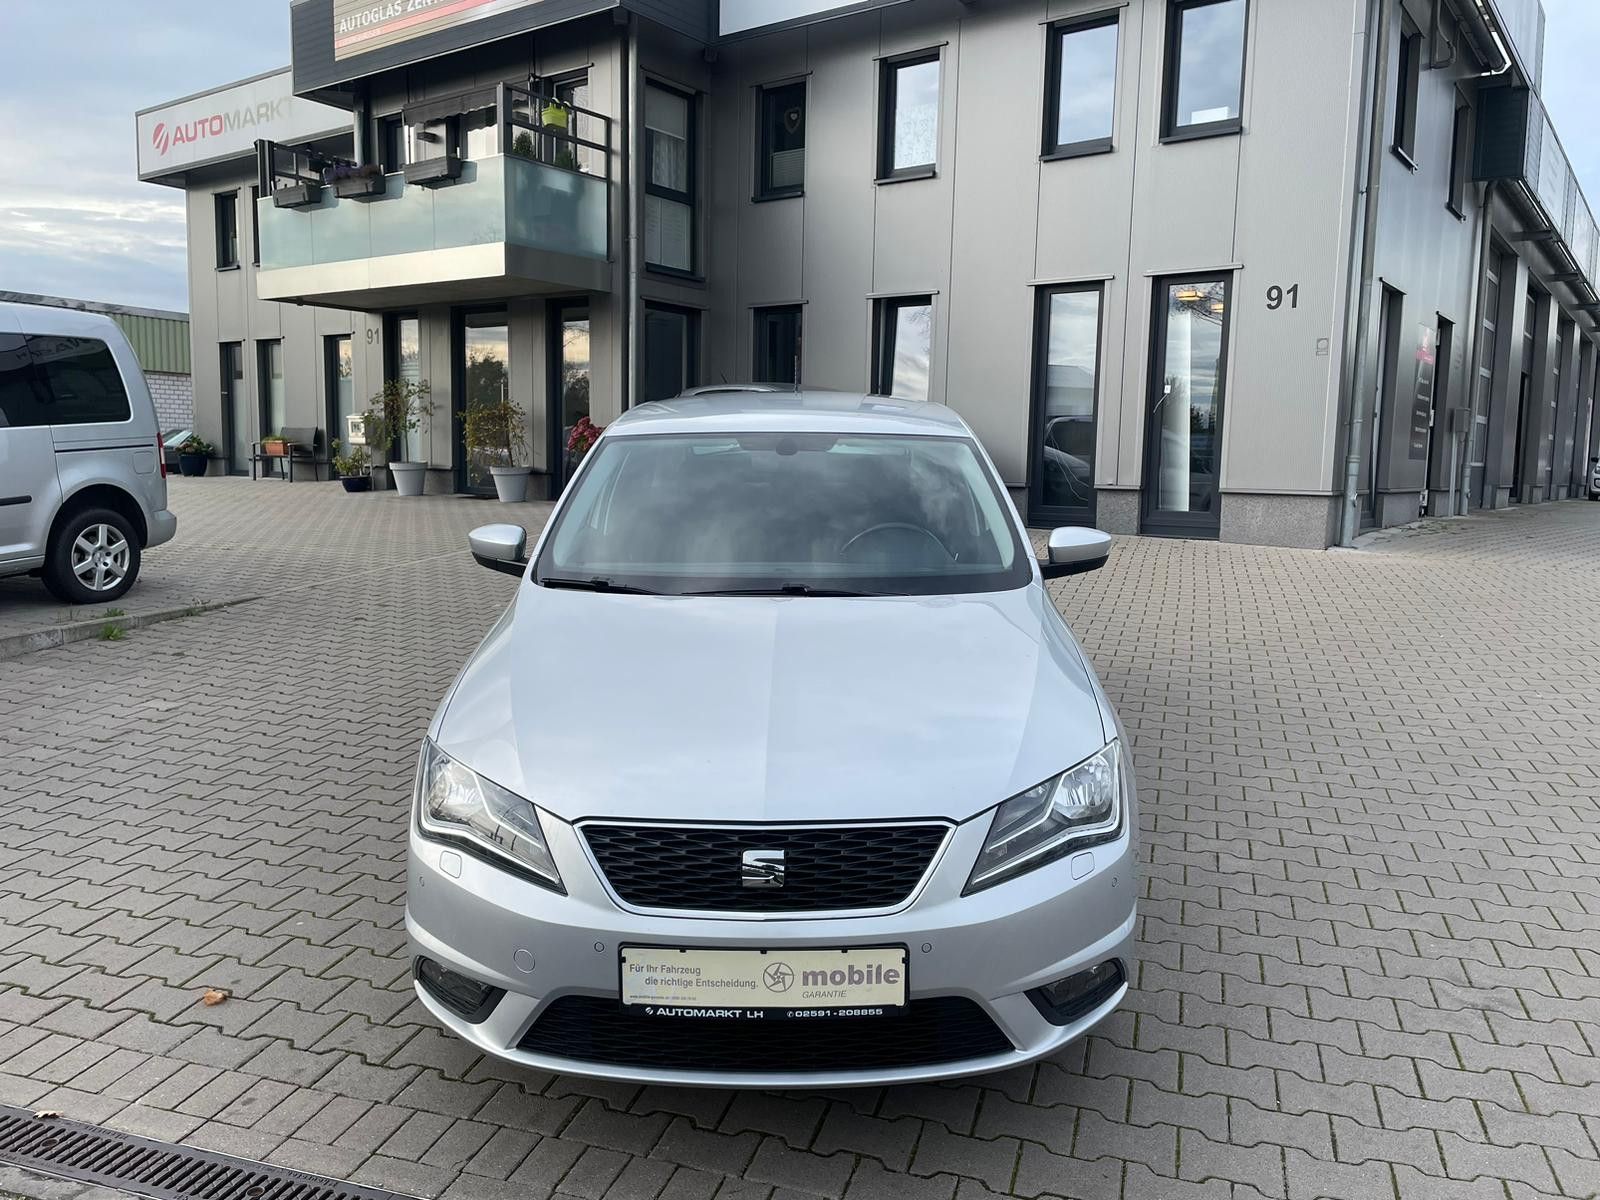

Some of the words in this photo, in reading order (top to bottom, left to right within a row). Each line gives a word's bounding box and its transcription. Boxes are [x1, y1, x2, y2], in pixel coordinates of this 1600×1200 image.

[338, 1, 402, 34] AUTOGLAS
[172, 96, 293, 147] AUTOMARKT
[1266, 283, 1299, 310] 91
[366, 327, 380, 345] 91
[629, 963, 644, 973] Für
[646, 964, 658, 973] Ihr
[660, 964, 701, 976] Fahrzeug
[802, 964, 900, 986] mobile
[645, 976, 658, 986] die
[660, 977, 693, 989] richtige
[695, 978, 759, 990] Entscheidung.
[802, 990, 847, 1000] GARANTIE
[656, 1008, 742, 1018] AUTOMARKT
[746, 1010, 764, 1019] LH
